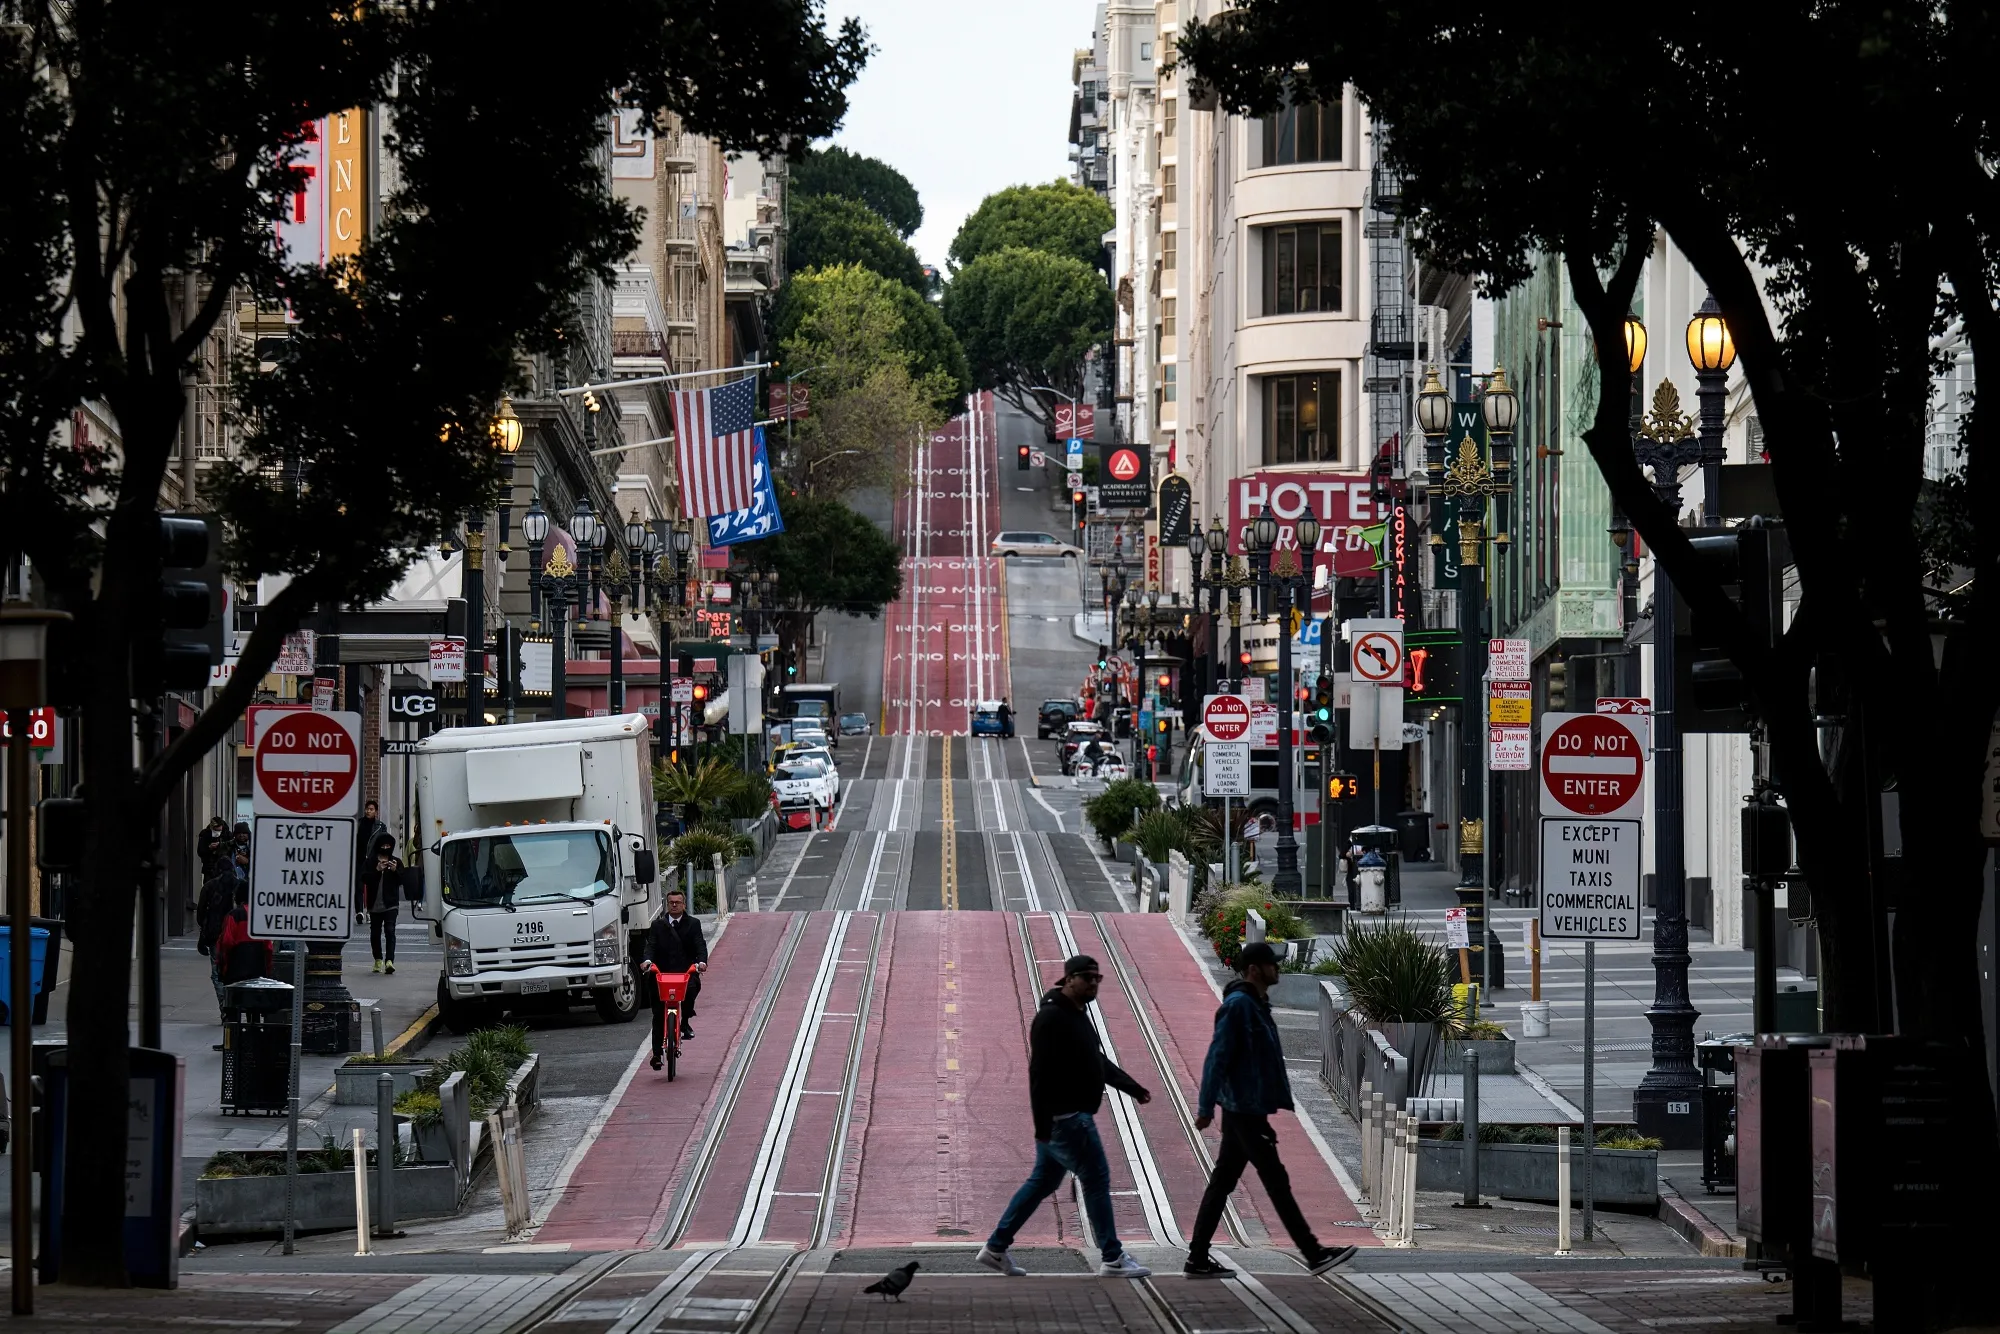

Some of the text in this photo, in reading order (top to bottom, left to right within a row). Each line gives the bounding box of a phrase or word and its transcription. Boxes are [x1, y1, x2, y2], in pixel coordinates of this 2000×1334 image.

[1162, 491, 1190, 543] STARLIGHT
[1148, 535, 1160, 582] PARK
[696, 609, 731, 622] Sears
[1491, 640, 1503, 652] NO
[433, 662, 461, 670] ANY TIME
[1491, 690, 1503, 698] NO
[391, 695, 436, 716] UGG
[1211, 704, 1243, 712] DO NOT
[1214, 723, 1240, 732] ENTER
[271, 732, 343, 749] DO NOT
[1491, 731, 1528, 741] NO PARKING
[1558, 734, 1629, 751] DO NOT
[386, 741, 415, 753] zum
[277, 777, 334, 794] ENTER
[1348, 779, 1357, 795] 5
[1563, 779, 1621, 796] ENTER
[276, 824, 334, 841] EXCEPT
[1563, 826, 1620, 842] EXCEPT
[285, 847, 322, 863] MUNI
[1572, 849, 1610, 864] MUNI
[281, 870, 325, 886] TAXIS
[1569, 871, 1613, 887] TAXIS
[257, 891, 346, 908] COMMERCIAL
[1546, 893, 1635, 910] COMMERCIAL
[264, 914, 338, 931] VEHICLES
[516, 921, 544, 934] 2196
[1554, 916, 1628, 932] VEHICLES
[513, 934, 550, 943] ISUZU
[1669, 1103, 1688, 1112] 151
